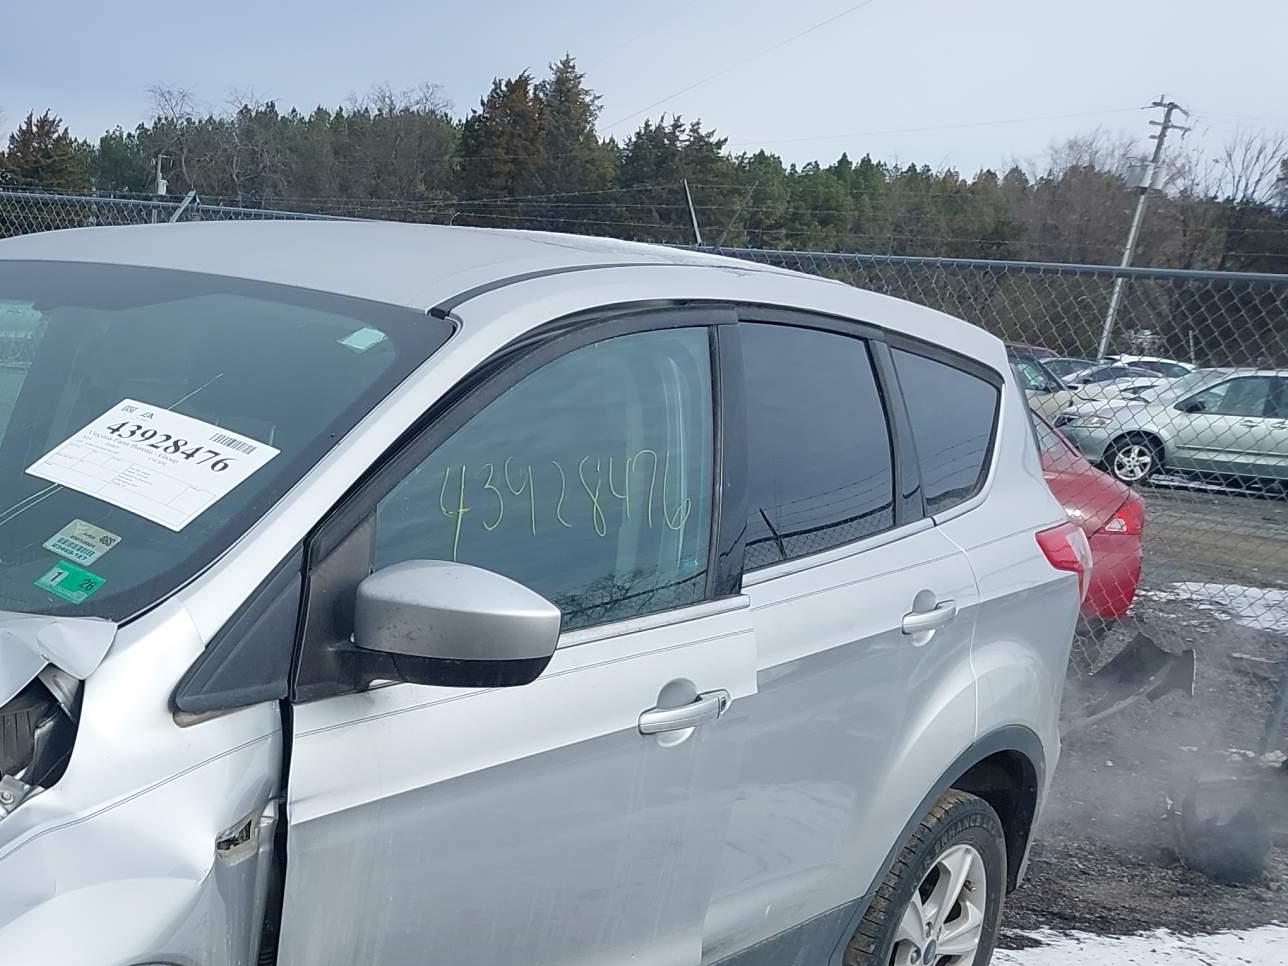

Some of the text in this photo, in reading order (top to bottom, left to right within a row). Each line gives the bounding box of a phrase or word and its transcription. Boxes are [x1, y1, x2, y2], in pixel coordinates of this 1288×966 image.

[106, 421, 237, 473] 43928476
[440, 449, 691, 561] 43928476
[51, 571, 64, 582] 1
[79, 578, 97, 591] 26
